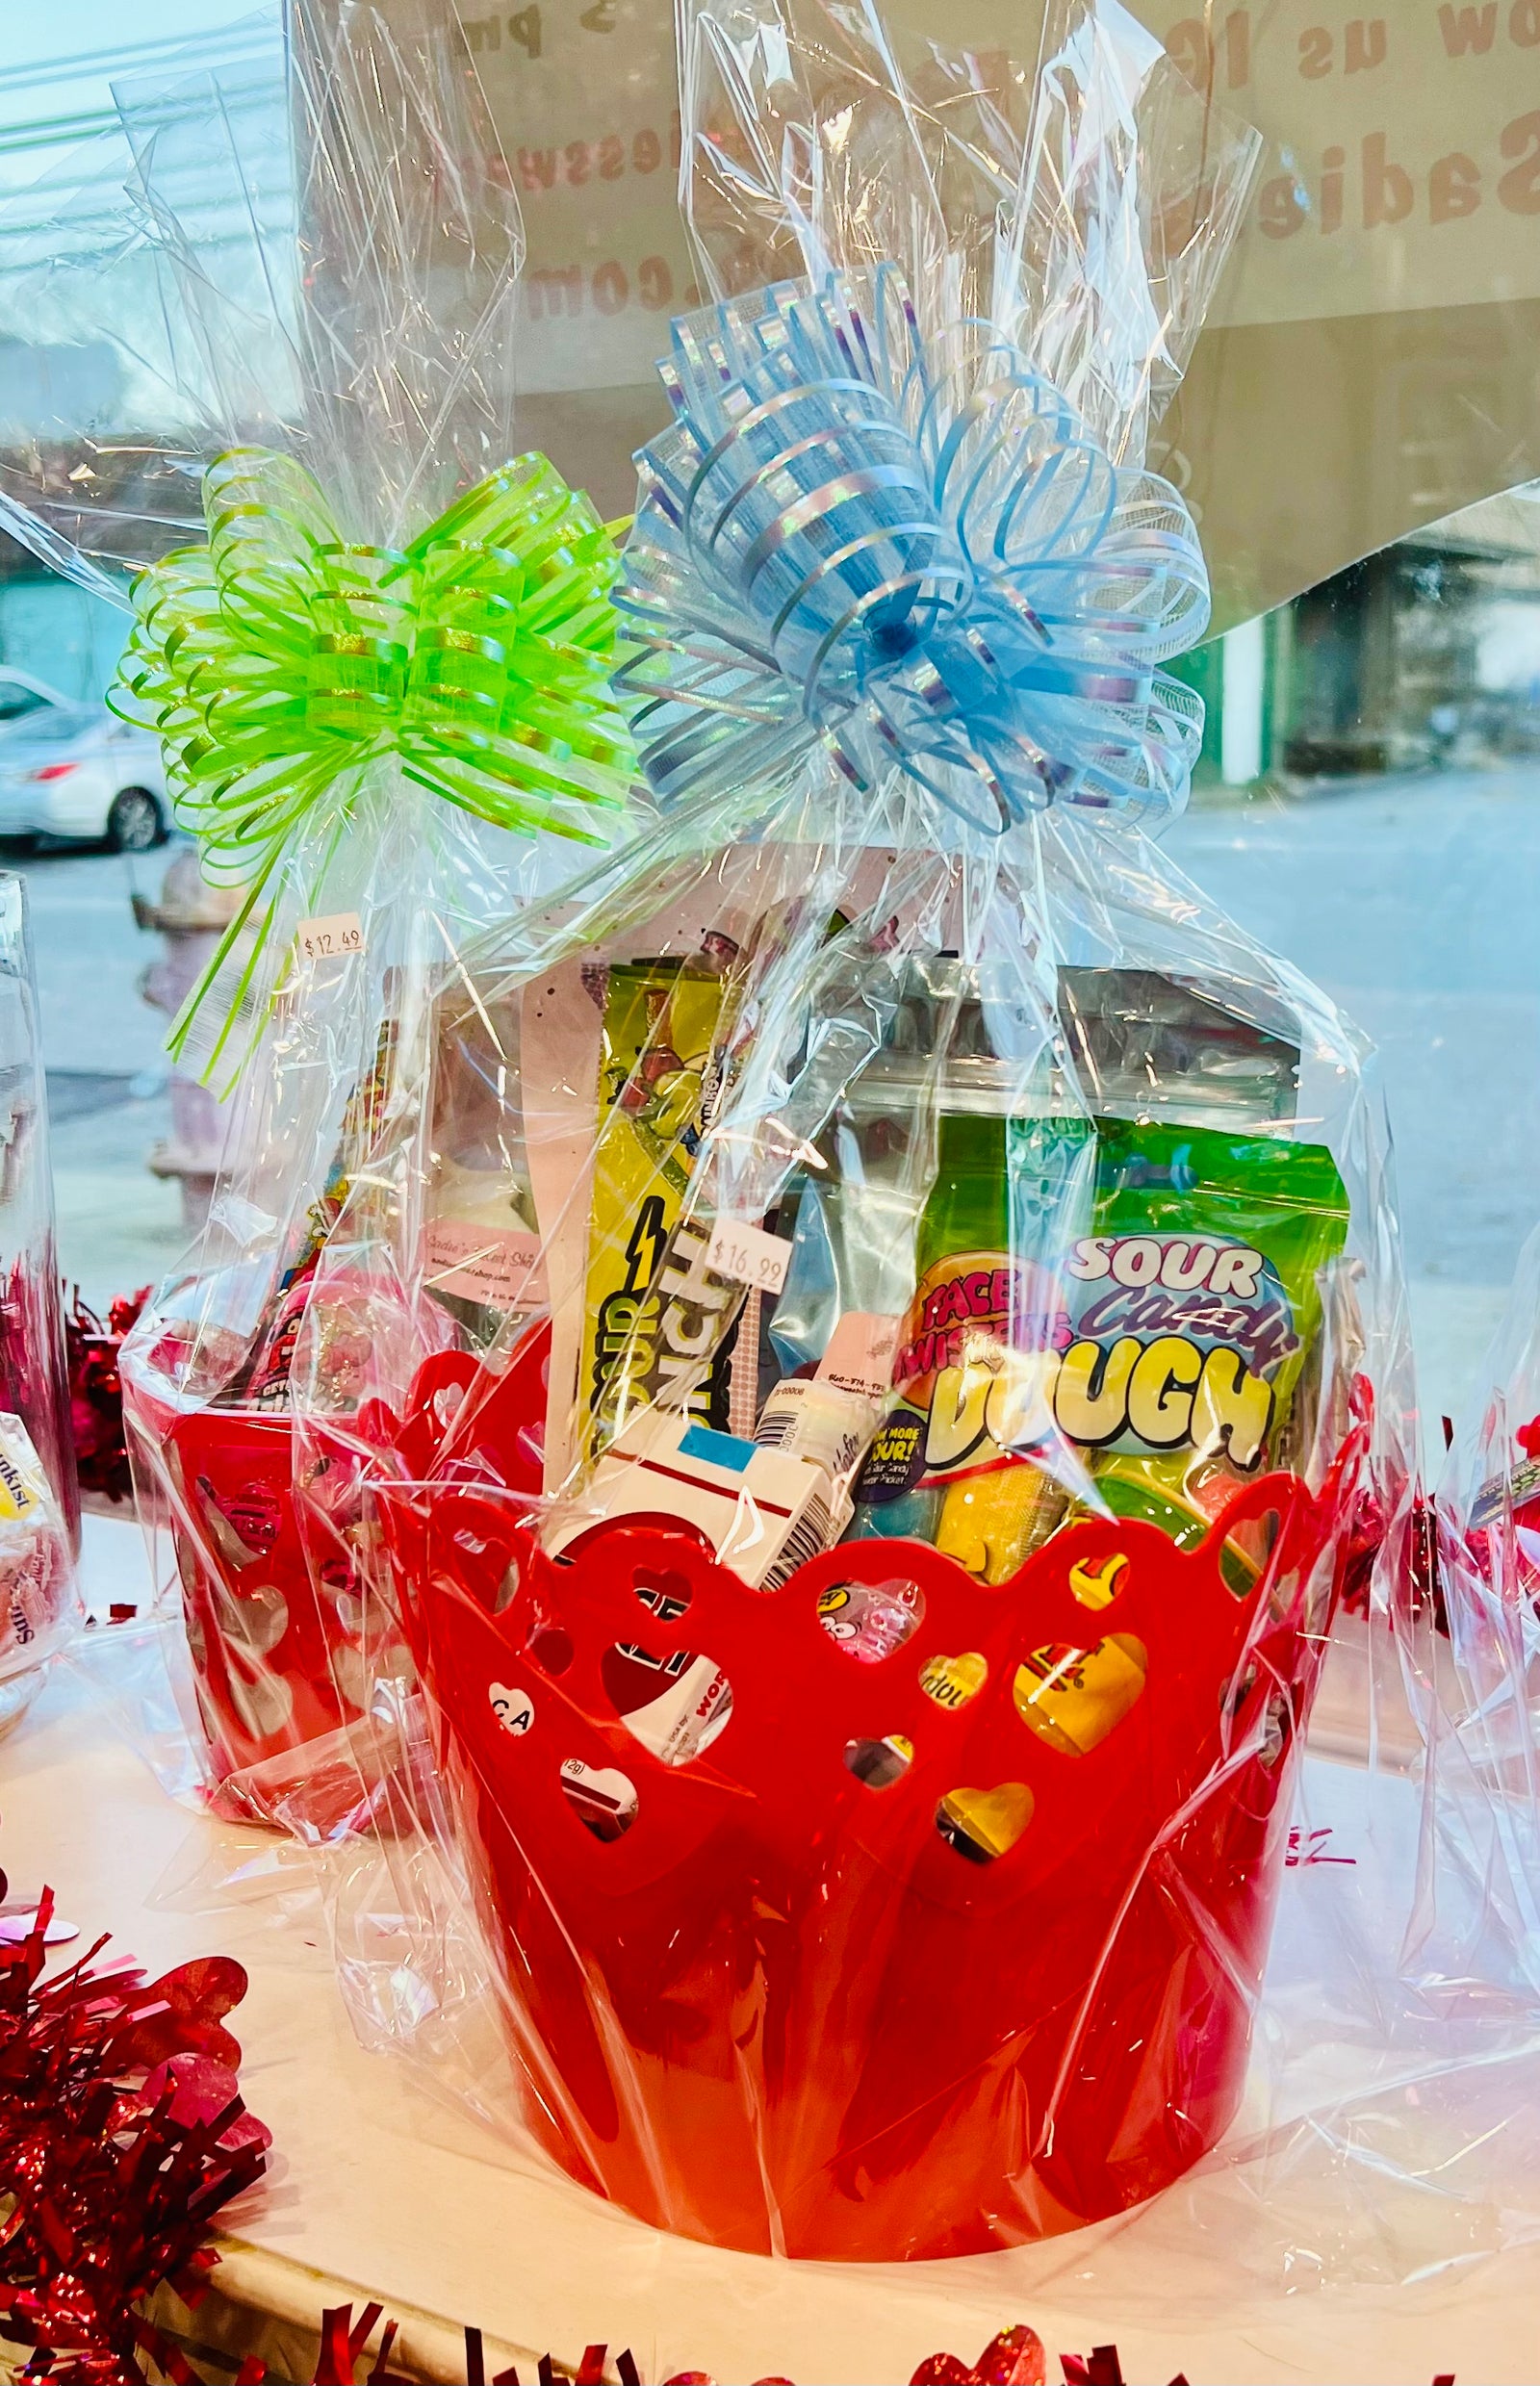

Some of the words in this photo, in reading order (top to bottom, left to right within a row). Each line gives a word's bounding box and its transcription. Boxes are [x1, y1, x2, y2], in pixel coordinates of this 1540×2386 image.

[305, 930, 362, 957] $12.49
[713, 1239, 782, 1287] $16.99
[1065, 1236, 1264, 1299] SOUR
[922, 1268, 1023, 1331] FACE
[1078, 1286, 1305, 1379] Candy
[889, 1427, 919, 1441] MORE
[926, 1335, 1275, 1473] DOUGH
